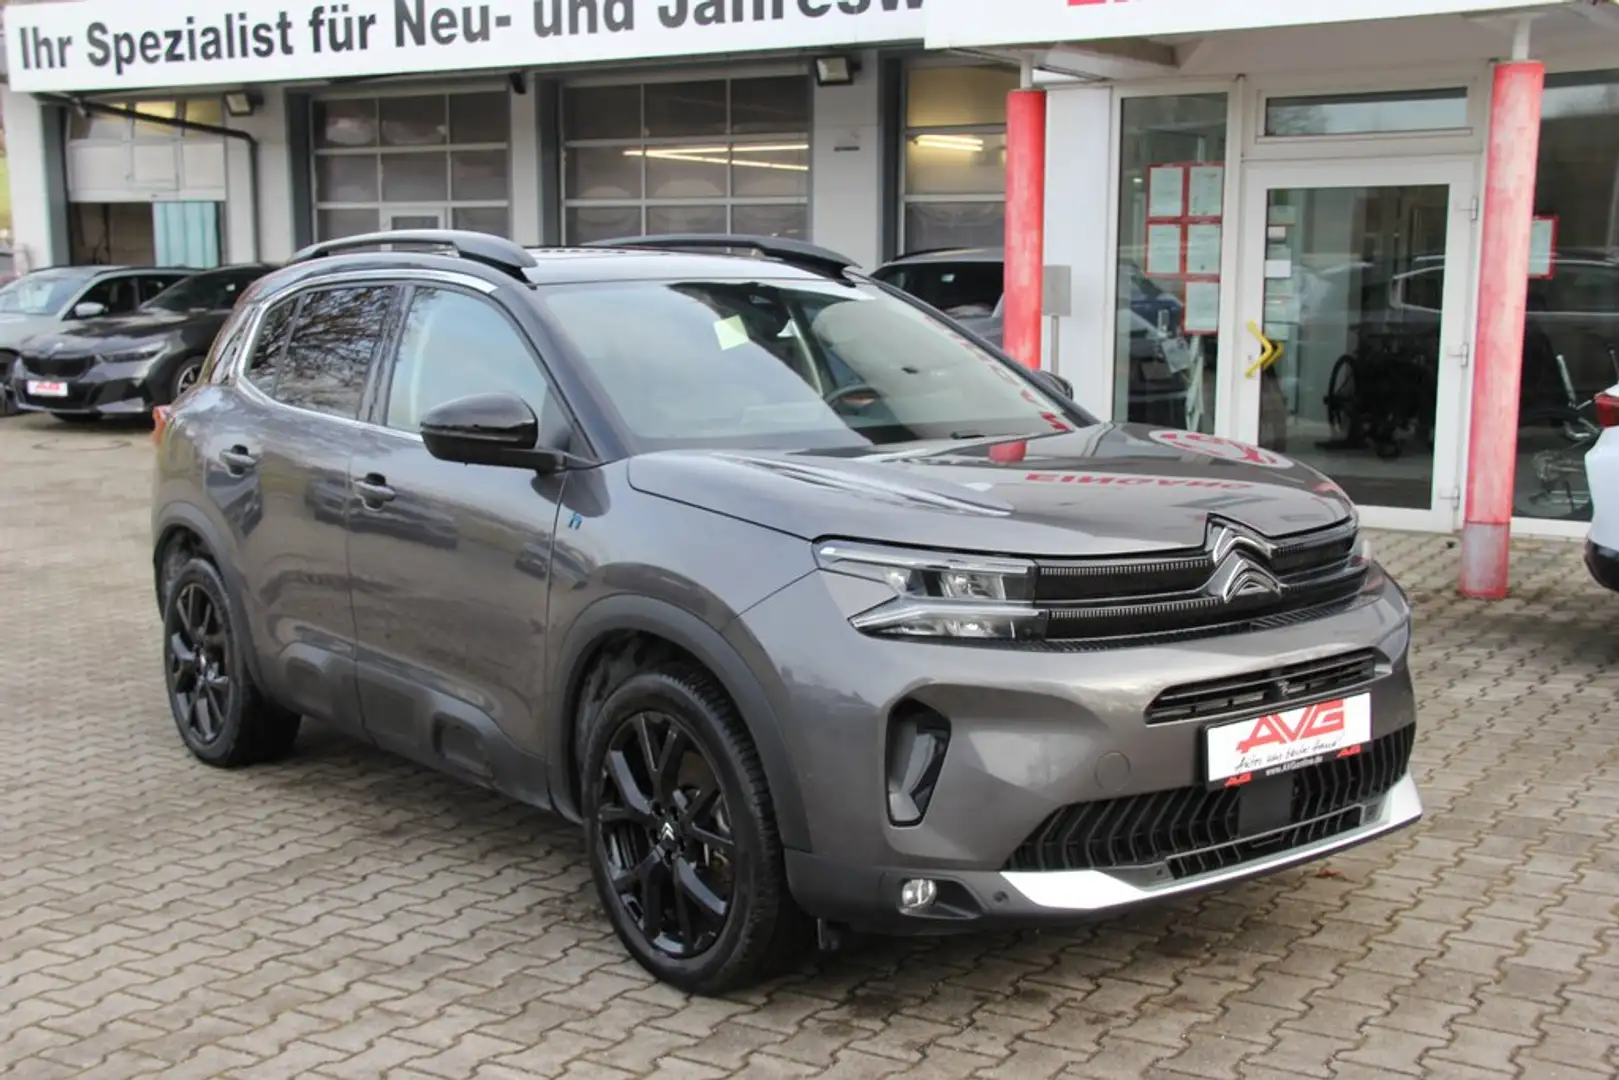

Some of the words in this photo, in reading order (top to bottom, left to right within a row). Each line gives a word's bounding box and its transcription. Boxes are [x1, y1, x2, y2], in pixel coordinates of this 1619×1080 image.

[19, 26, 73, 70] Ihr
[86, 11, 294, 75] Spezialist
[308, 4, 377, 54] für
[394, 0, 511, 47] Neu-
[534, 0, 634, 38] und
[1236, 698, 1345, 754] AVG
